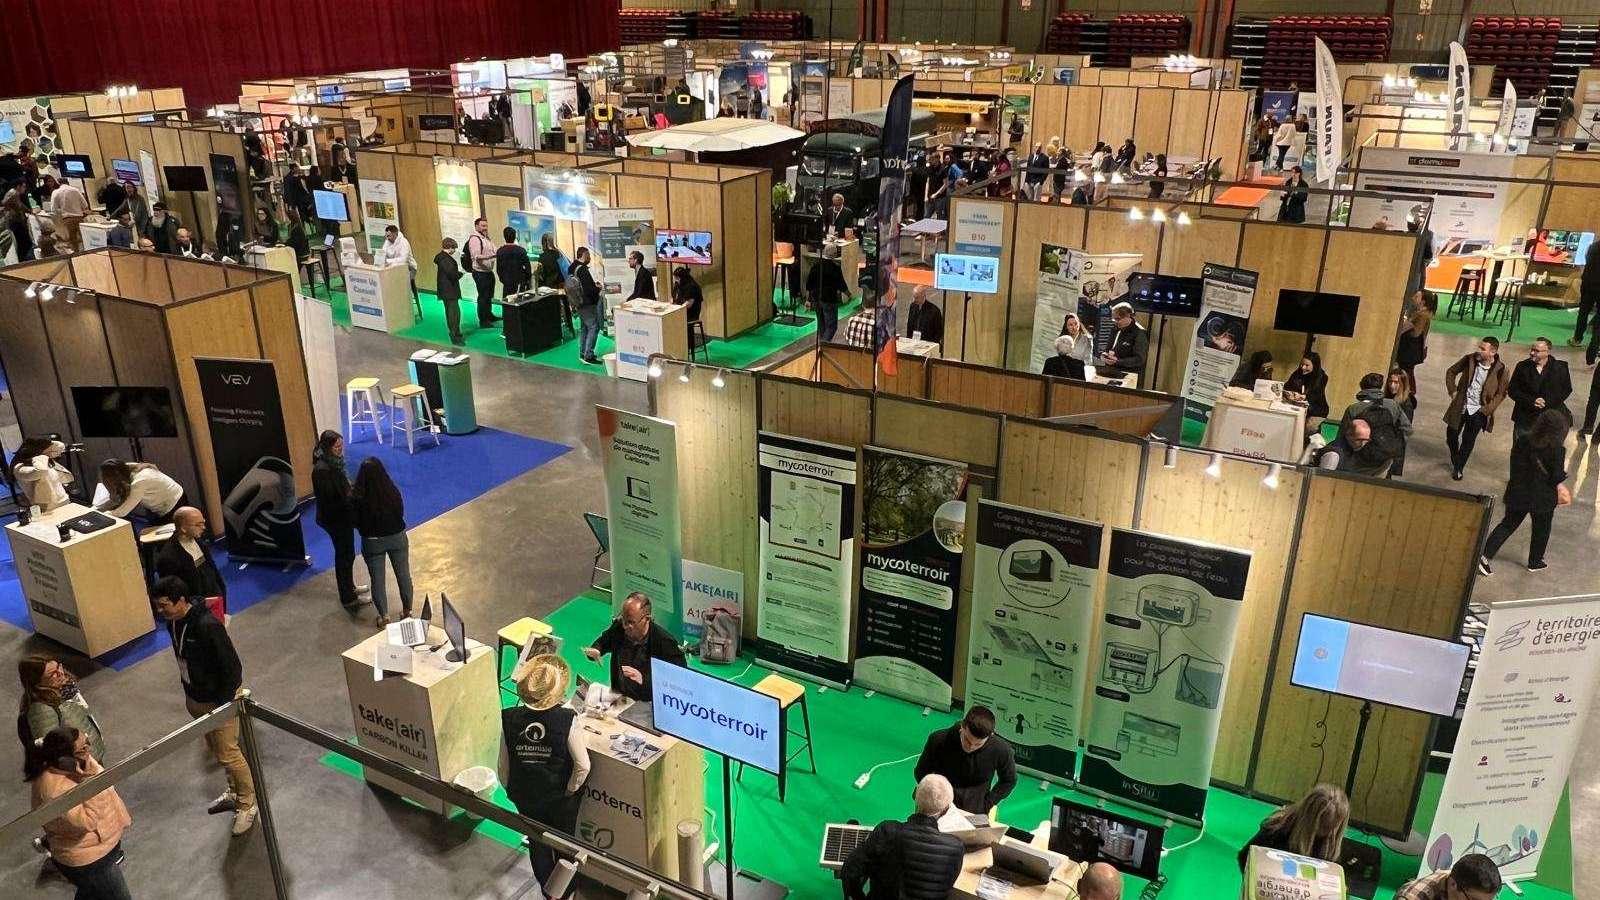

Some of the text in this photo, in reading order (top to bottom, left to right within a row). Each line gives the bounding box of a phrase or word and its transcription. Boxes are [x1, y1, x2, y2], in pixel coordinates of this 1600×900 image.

[220, 374, 252, 385] VEV
[778, 459, 835, 477] mycoterroir
[867, 552, 950, 582] mycoterroir
[1536, 613, 1600, 632] territoire
[1532, 629, 1600, 646] d'énergie
[358, 703, 428, 750] take[air]
[662, 693, 768, 741] mycoterroir
[361, 726, 429, 762] CARBON KILLER
